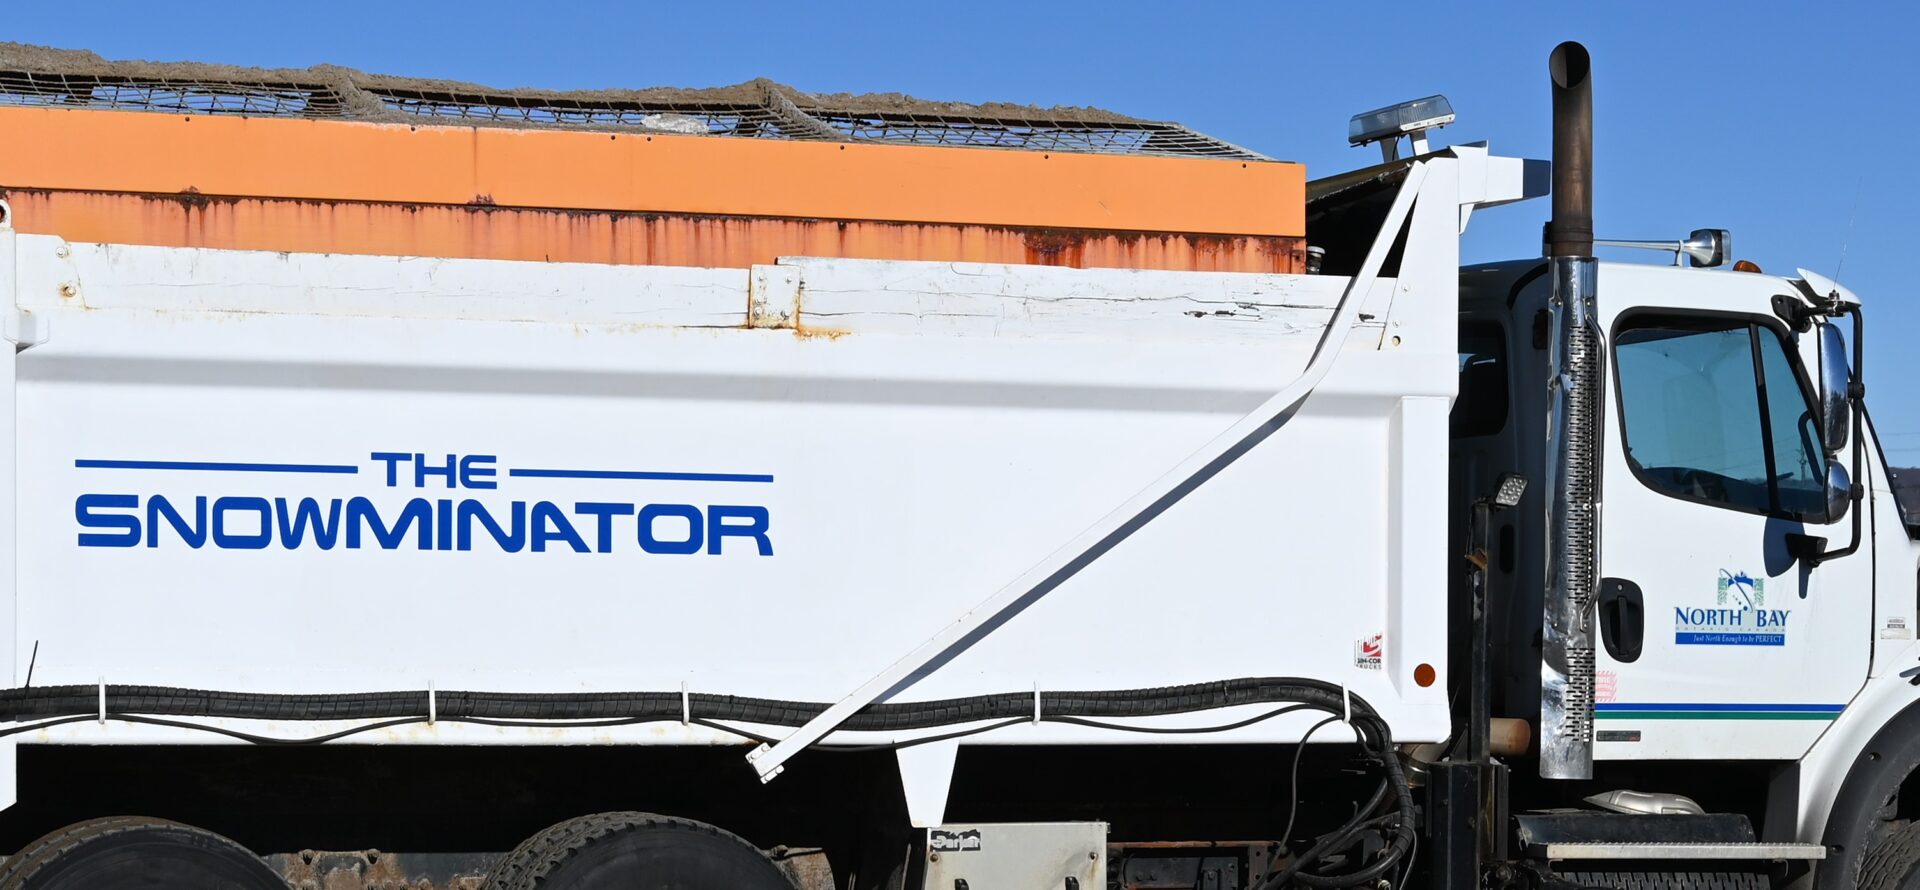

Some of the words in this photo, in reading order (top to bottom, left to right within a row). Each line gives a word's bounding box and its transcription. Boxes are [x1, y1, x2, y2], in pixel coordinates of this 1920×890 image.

[371, 452, 498, 489] THE
[75, 493, 774, 557] SNOWMINATOR
[1674, 607, 1742, 626] NORTH
[1755, 609, 1791, 627] BAY
[1693, 634, 1704, 643] Just
[1705, 634, 1721, 642] North
[1722, 634, 1742, 644] Enough
[1755, 635, 1782, 643] PERFECT
